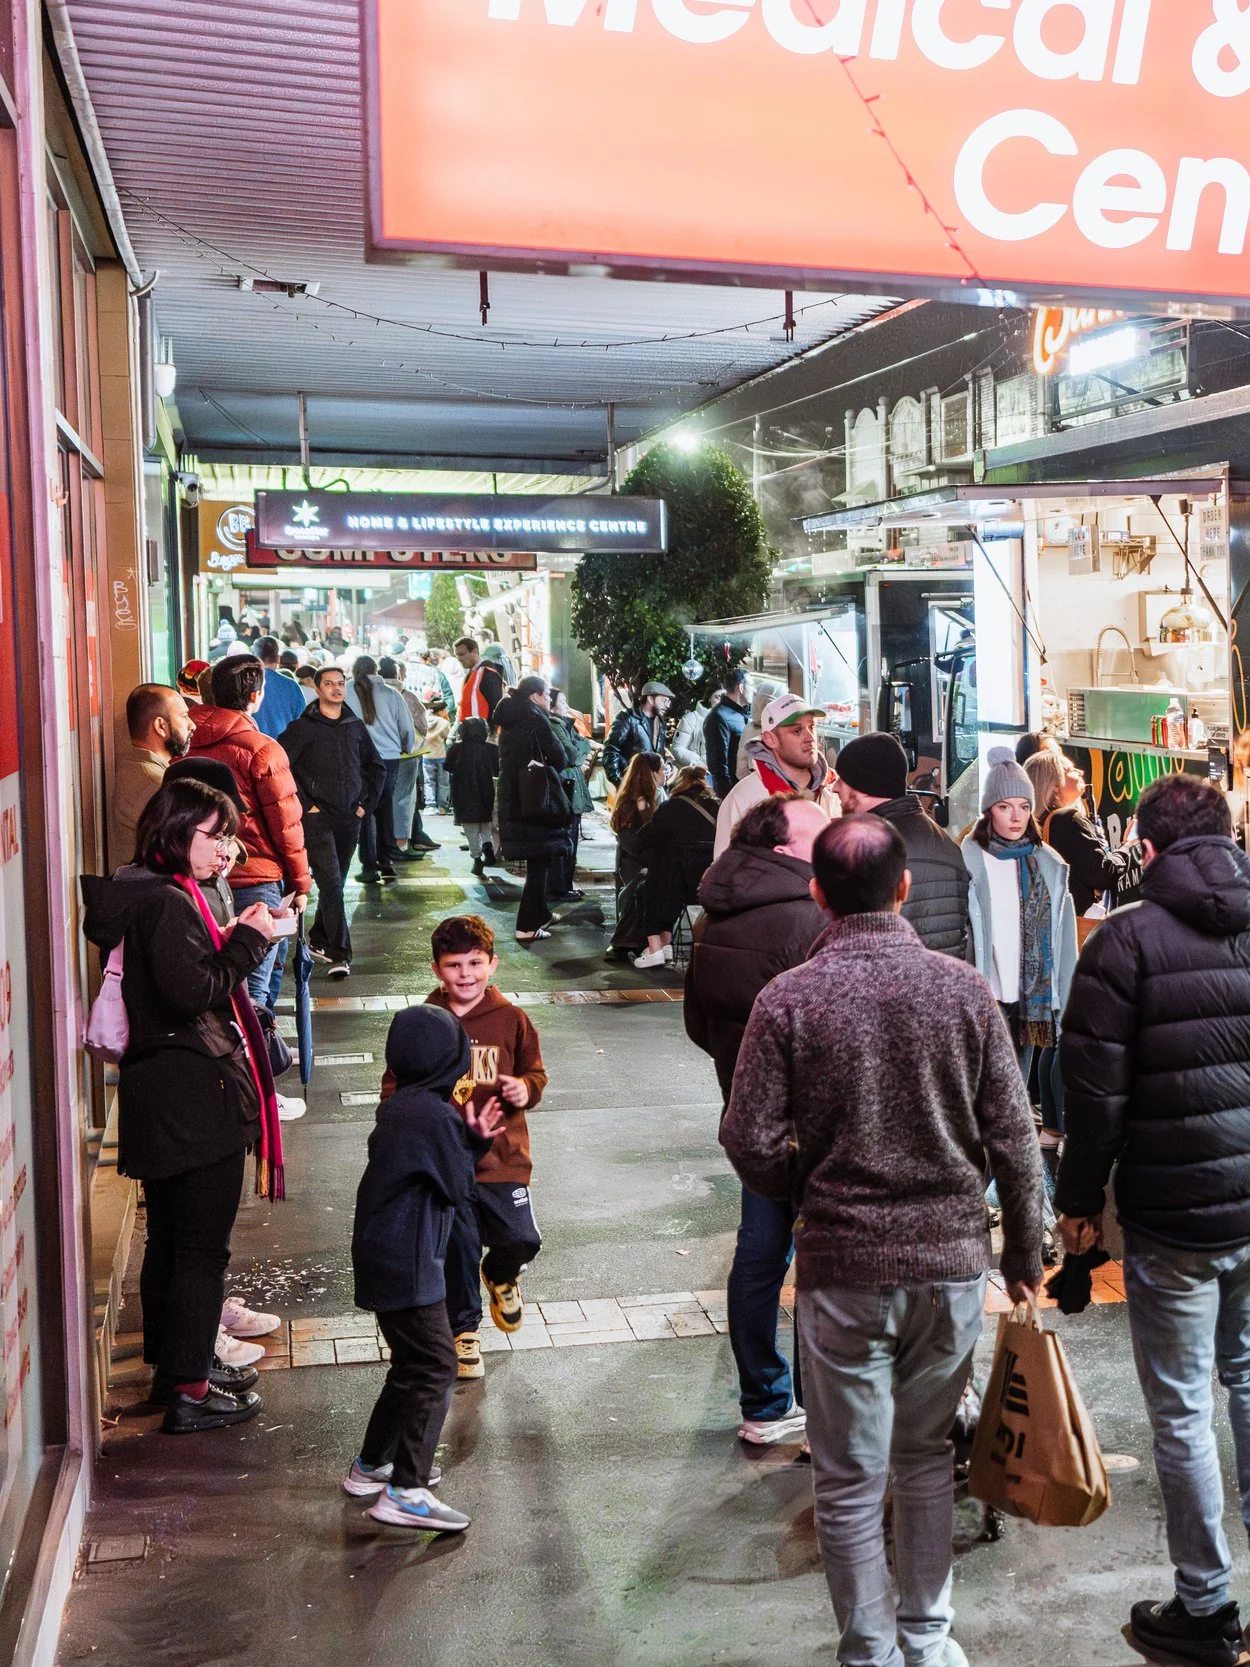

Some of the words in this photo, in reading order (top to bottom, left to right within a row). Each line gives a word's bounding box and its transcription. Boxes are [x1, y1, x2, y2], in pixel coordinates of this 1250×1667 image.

[347, 515, 394, 530] HOME
[412, 516, 491, 531] LIFESTYLE
[493, 518, 586, 532] EXPERIENCE
[589, 520, 648, 534] CENTRE
